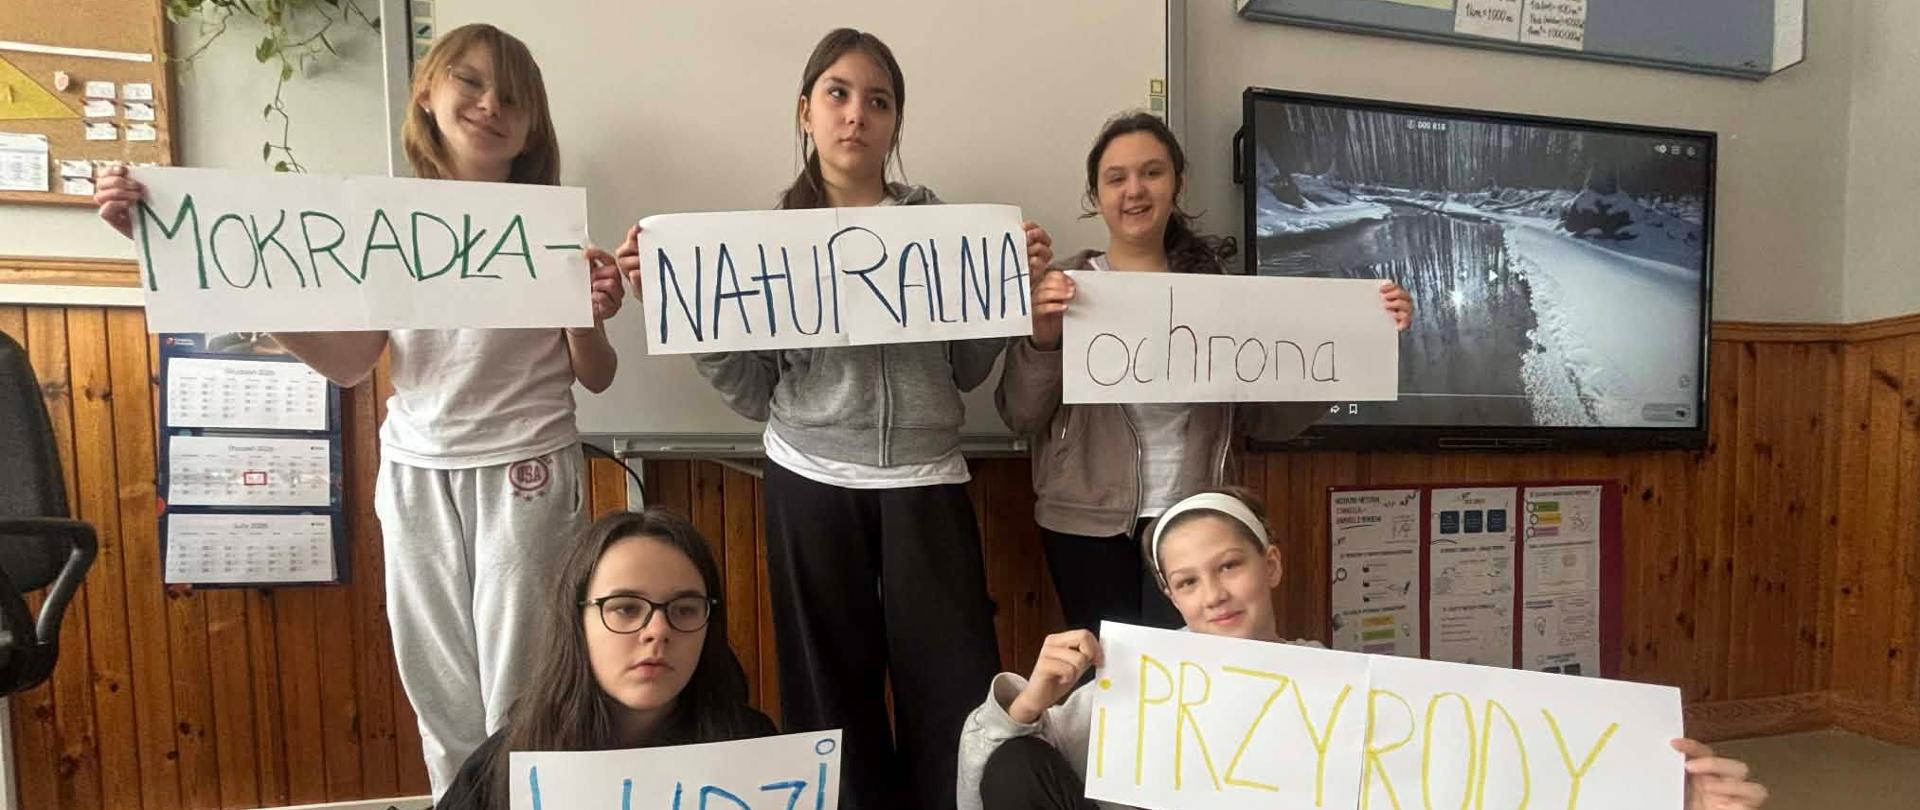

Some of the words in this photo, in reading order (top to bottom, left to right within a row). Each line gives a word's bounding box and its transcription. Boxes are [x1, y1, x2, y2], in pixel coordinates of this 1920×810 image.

[1086, 285, 1342, 387] ochrona
[517, 464, 542, 483] USA
[1096, 678, 1113, 779] i
[1134, 654, 1619, 810] PRZYRODY
